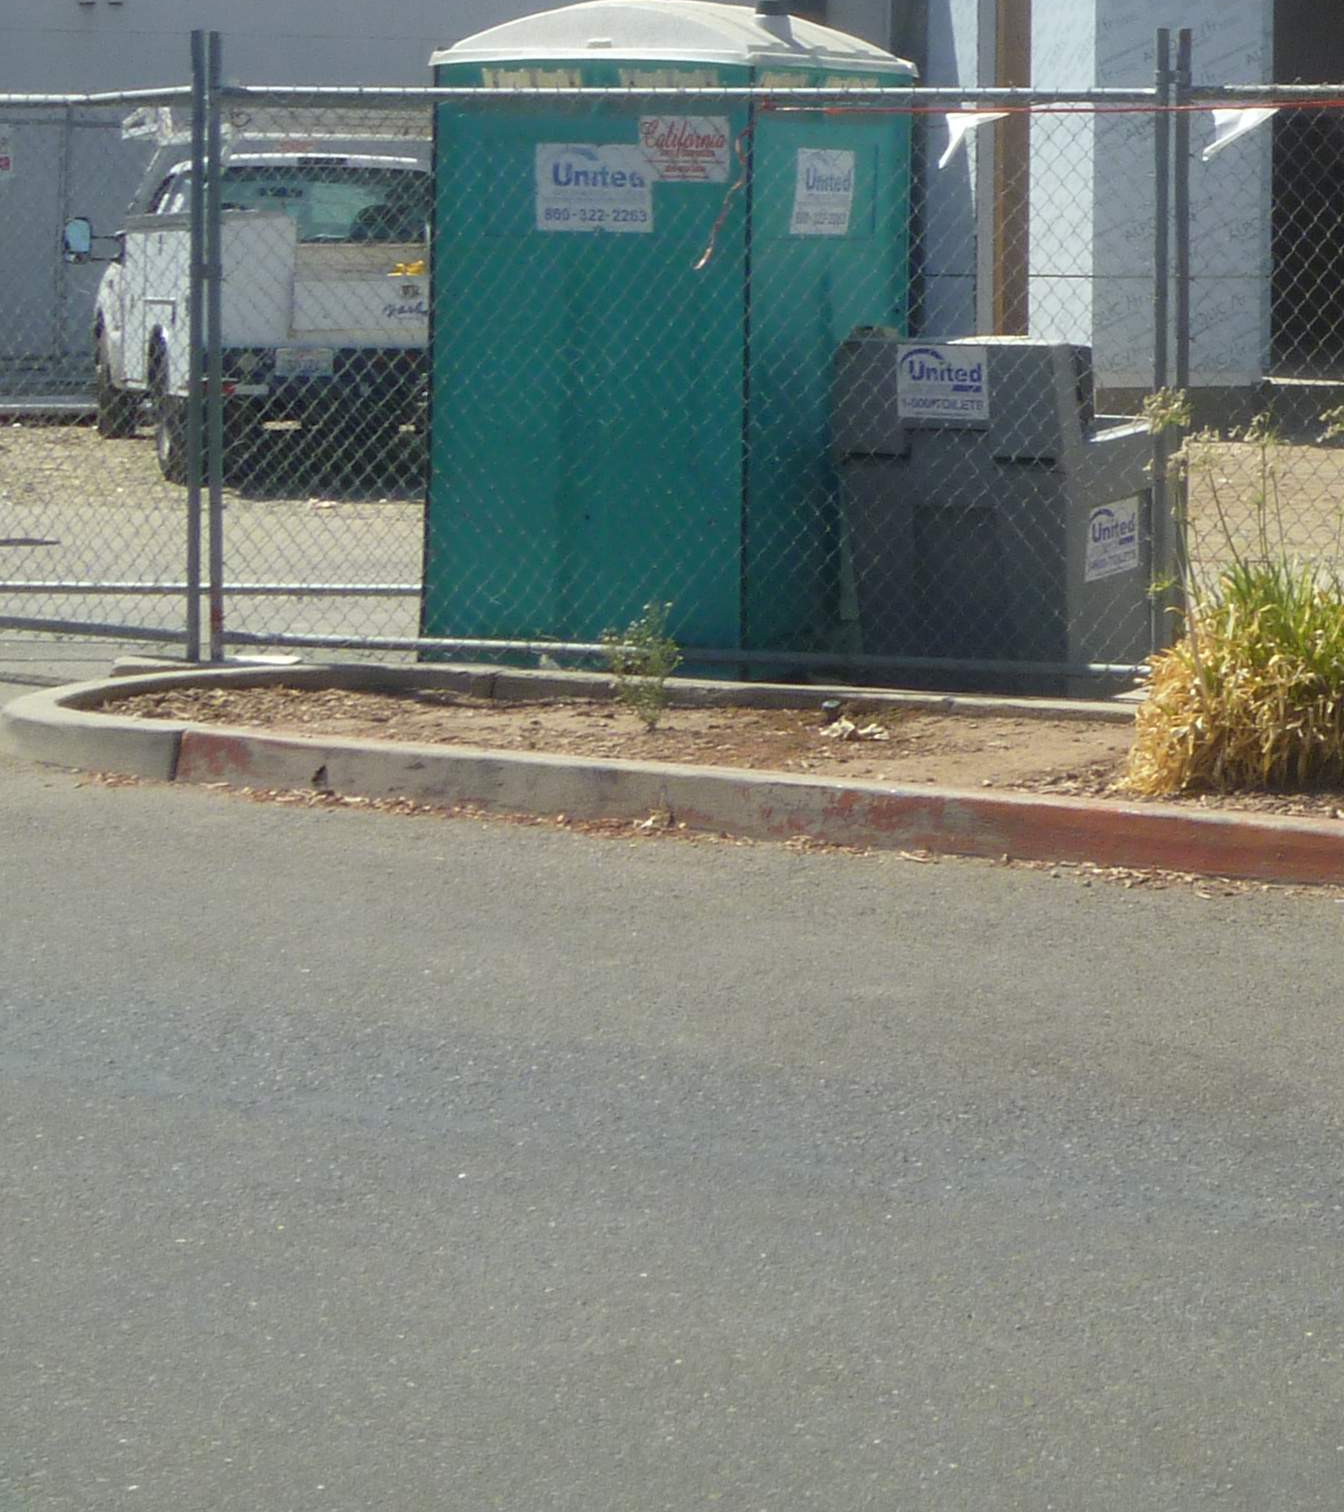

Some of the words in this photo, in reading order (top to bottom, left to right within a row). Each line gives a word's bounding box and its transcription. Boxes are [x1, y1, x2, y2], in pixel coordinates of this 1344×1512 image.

[640, 118, 726, 156] California
[806, 167, 852, 193] United
[909, 359, 982, 383] United
[1092, 512, 1136, 543] United
